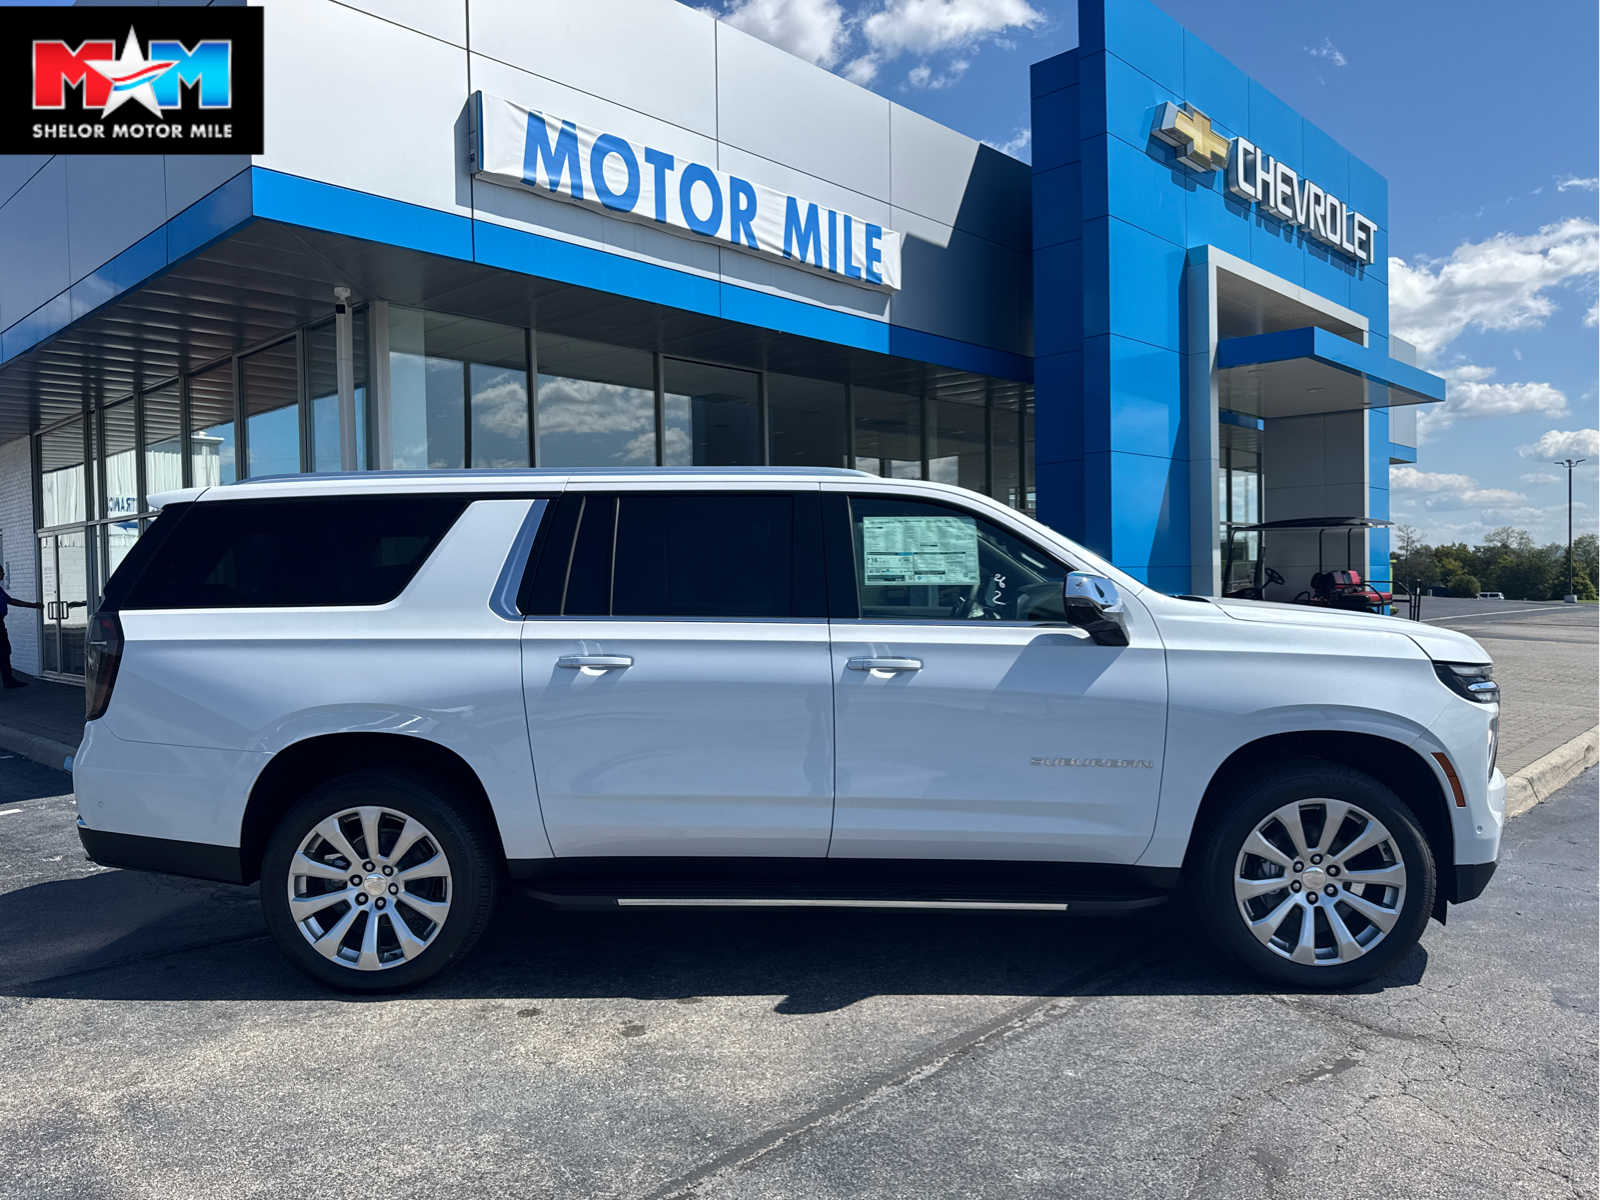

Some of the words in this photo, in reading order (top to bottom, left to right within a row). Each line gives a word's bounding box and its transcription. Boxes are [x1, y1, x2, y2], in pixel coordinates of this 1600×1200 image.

[521, 110, 760, 250] MOTOR
[782, 195, 883, 285] MILE
[1236, 136, 1378, 265] CHEVROLET
[1029, 757, 1153, 768] SUBURBAN
